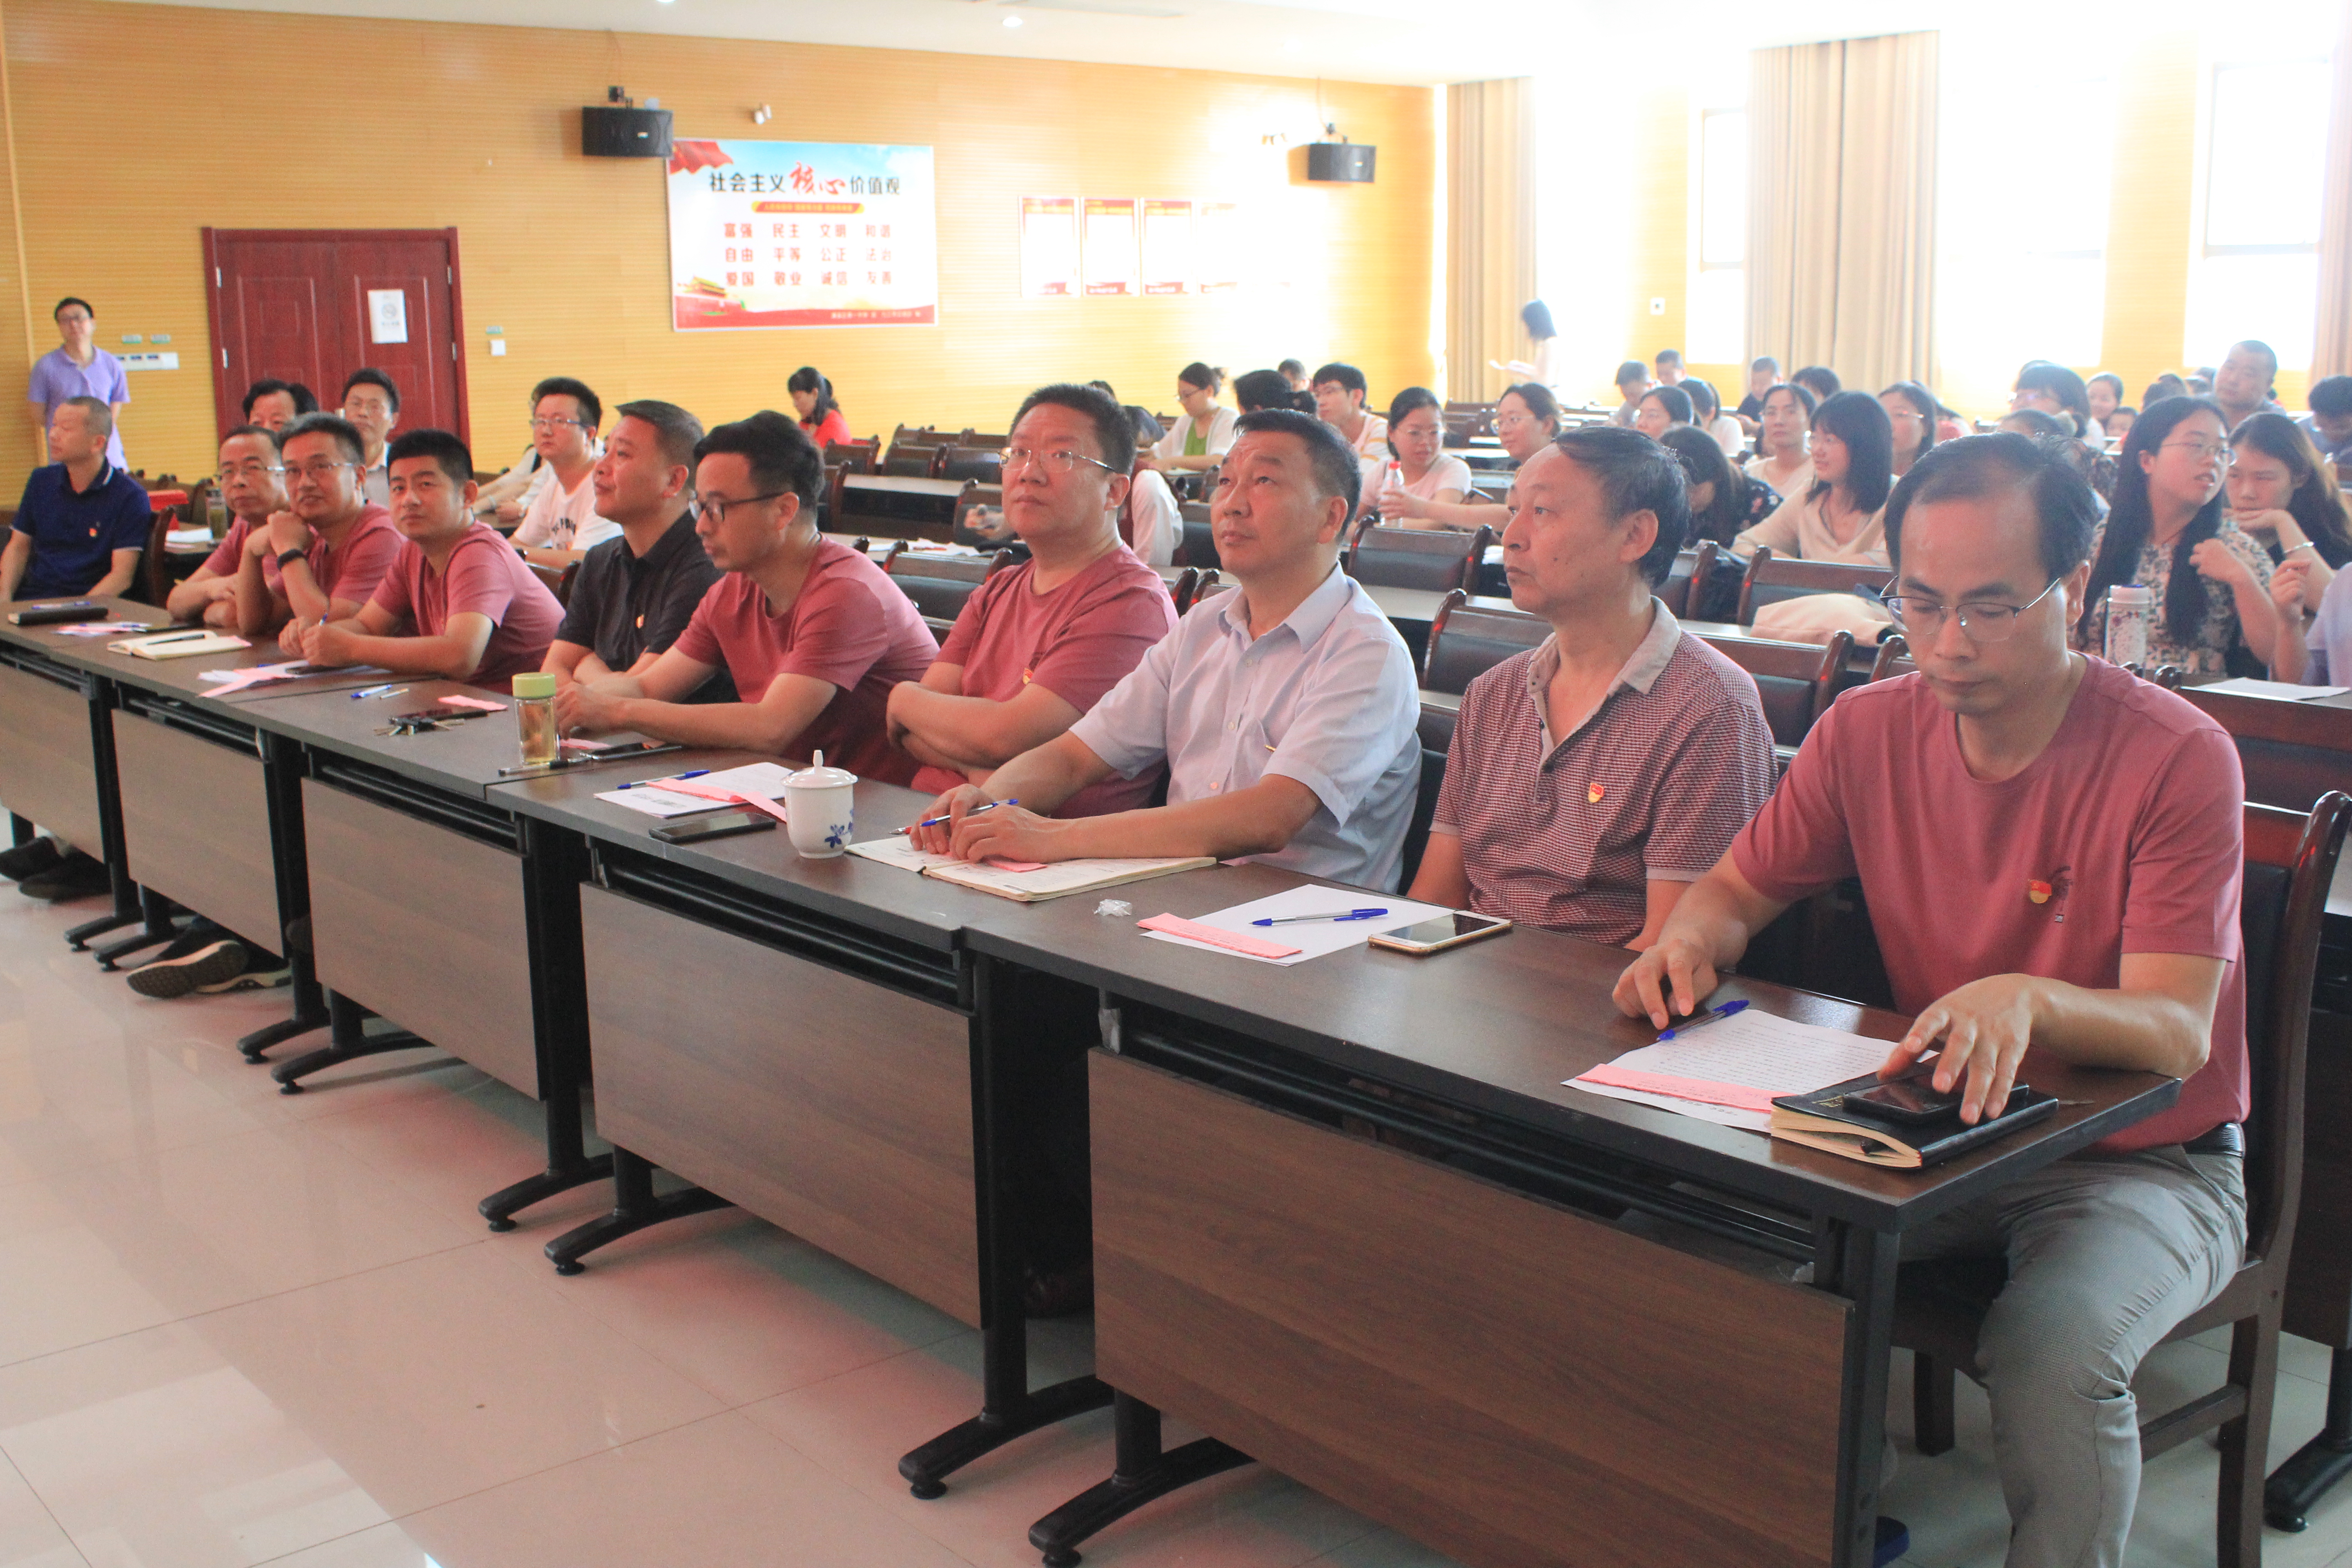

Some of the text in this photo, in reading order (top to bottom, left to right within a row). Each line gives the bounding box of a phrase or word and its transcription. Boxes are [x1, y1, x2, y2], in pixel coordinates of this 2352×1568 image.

[709, 160, 900, 196] 社会主义核心价值观
[724, 223, 891, 238] 富强 民主 文明 和谐
[725, 247, 891, 262] 自由 平等 公正 法治
[726, 271, 892, 286] 爱国 敬业 诚信 友善
